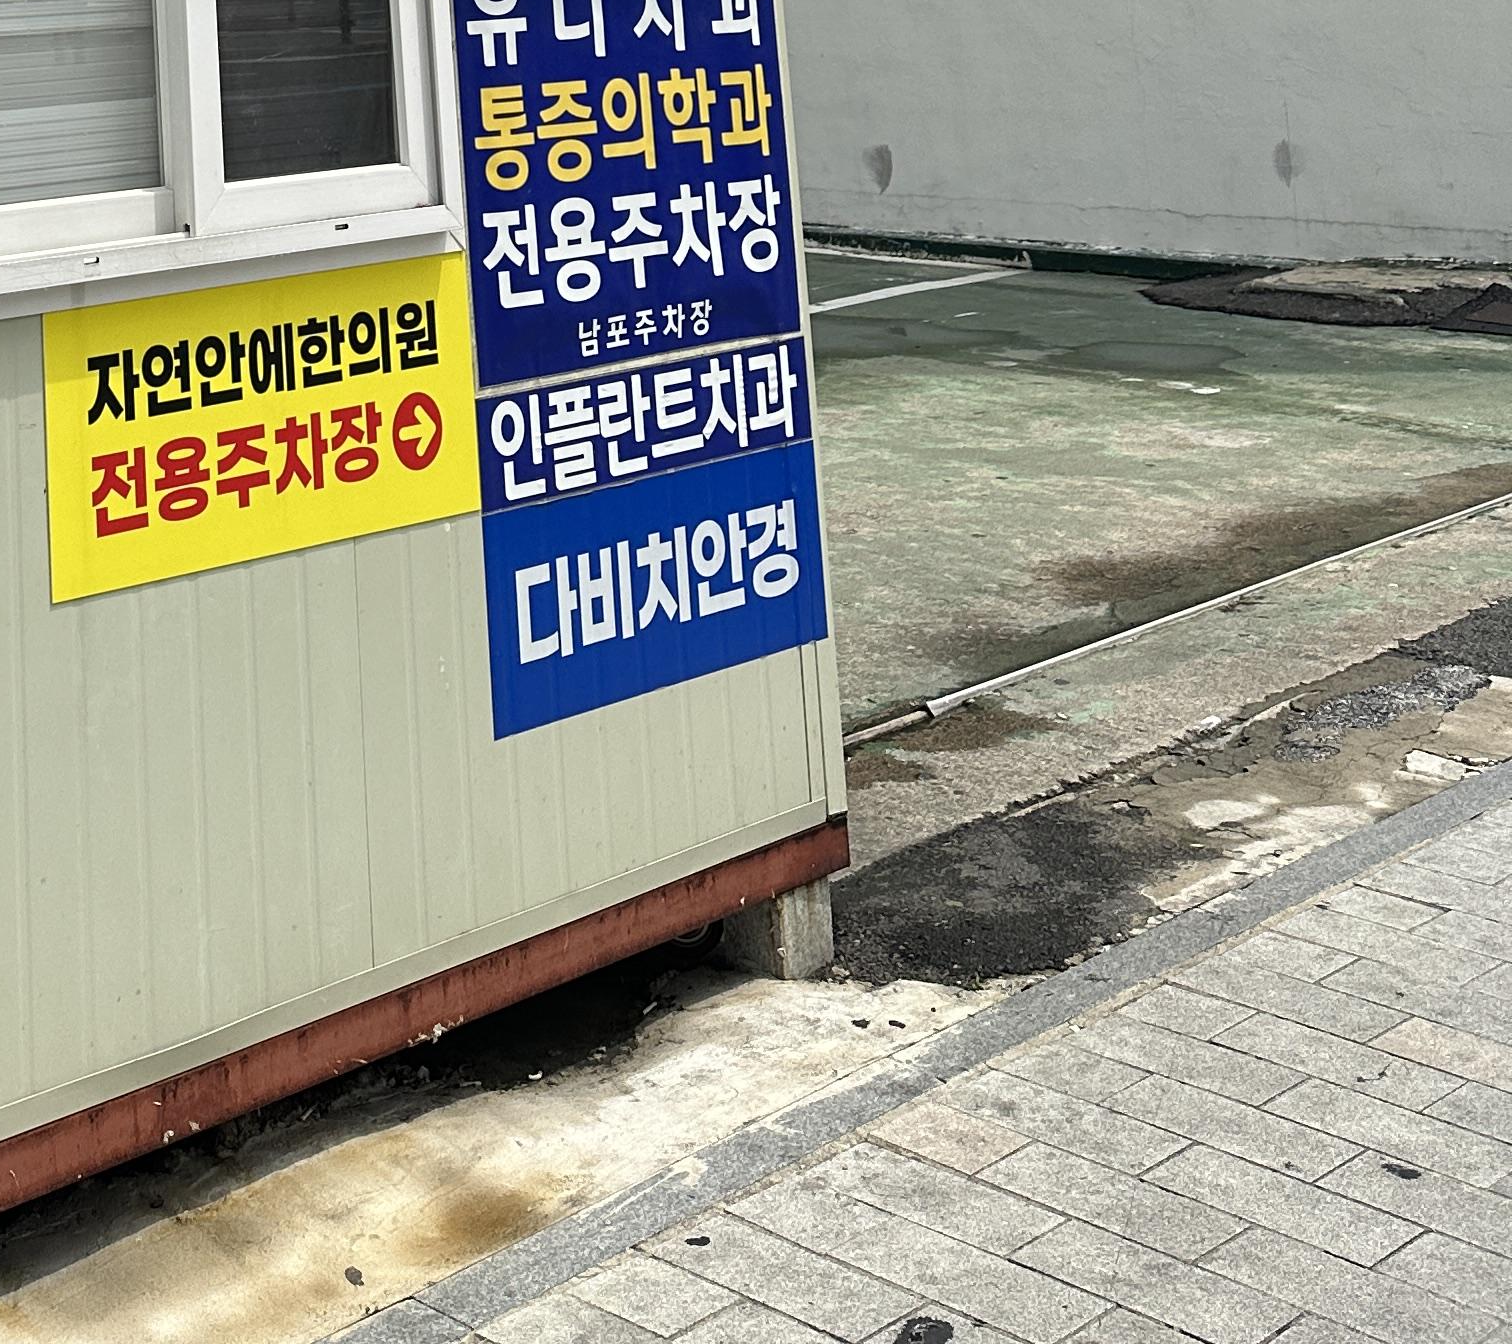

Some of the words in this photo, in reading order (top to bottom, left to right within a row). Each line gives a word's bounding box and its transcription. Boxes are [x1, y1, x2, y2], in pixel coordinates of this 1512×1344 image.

[474, 64, 773, 191] 통증의학과
[482, 174, 782, 310] 전용주차장
[87, 299, 440, 425] 자연안에한의원
[578, 299, 713, 358] 남포주차장
[91, 401, 383, 539] 전용주차장
[491, 344, 799, 502] 인플란트치과
[515, 498, 800, 667] 다비치안경
